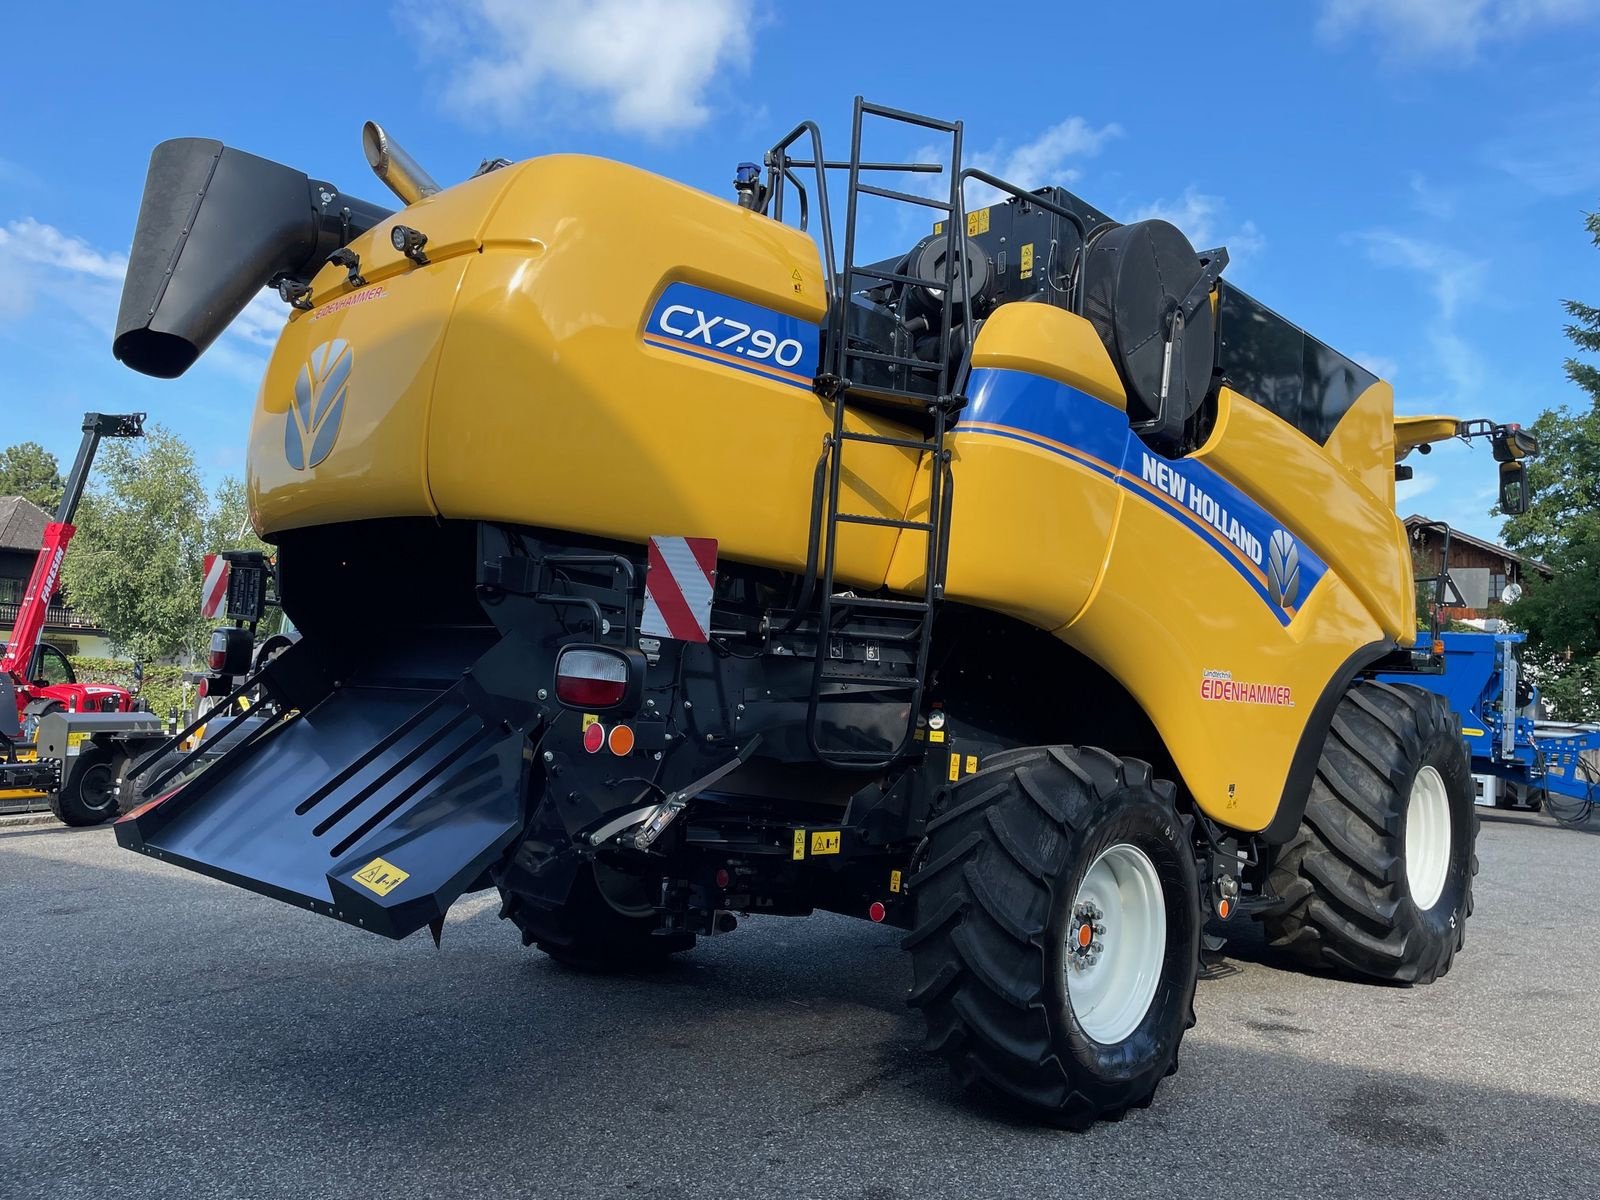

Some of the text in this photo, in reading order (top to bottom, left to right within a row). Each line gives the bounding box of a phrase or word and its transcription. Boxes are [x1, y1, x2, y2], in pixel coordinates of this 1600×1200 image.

[315, 286, 384, 319] EIDENHAMMER
[659, 304, 803, 367] CX7.90
[1142, 451, 1263, 566] NEW HOLLAND
[40, 545, 64, 604] FARESIN
[1201, 679, 1291, 705] EIDENHAMMER
[1203, 669, 1231, 679] Landtechnik
